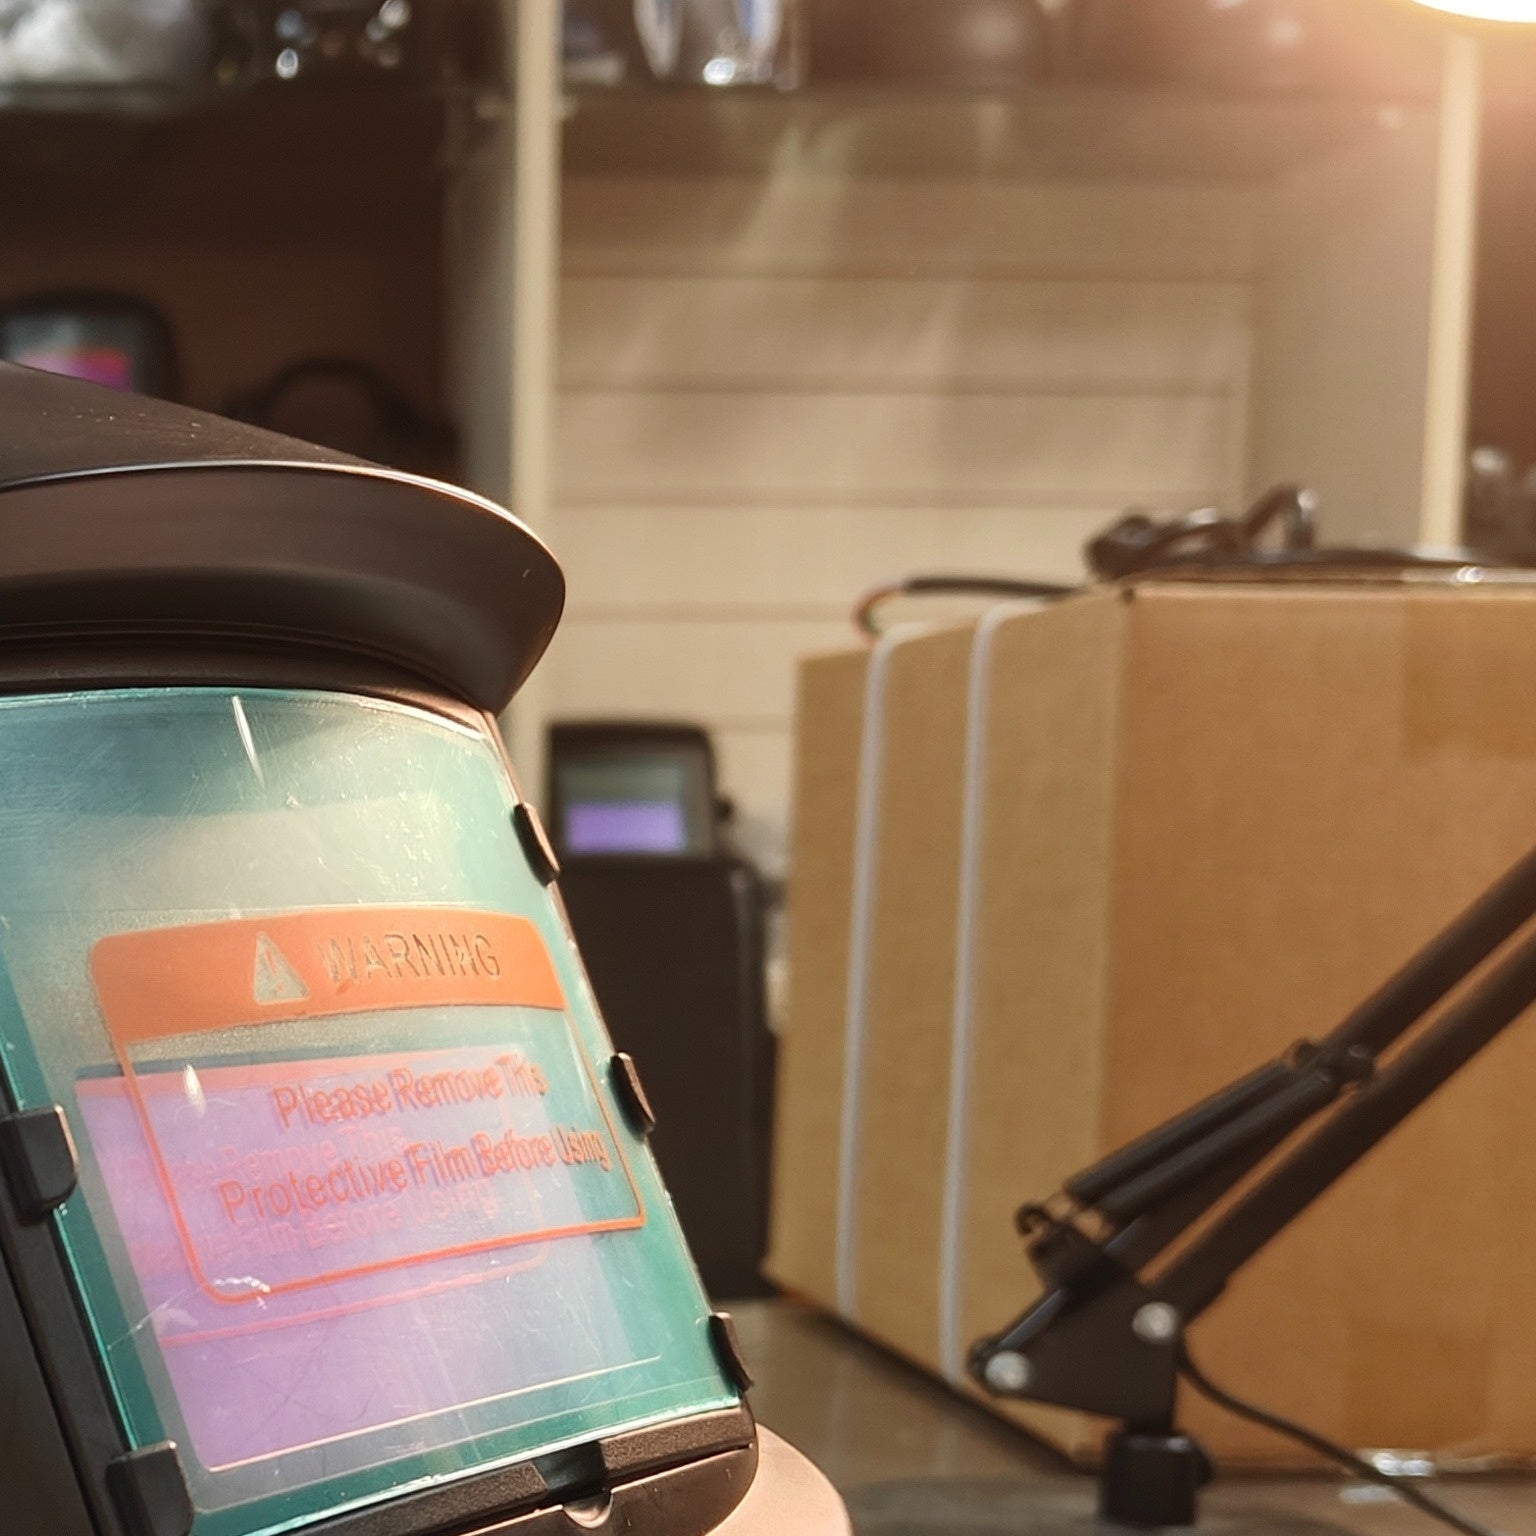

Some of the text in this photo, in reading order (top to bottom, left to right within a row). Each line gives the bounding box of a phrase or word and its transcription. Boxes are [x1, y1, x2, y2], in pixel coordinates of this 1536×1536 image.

[316, 933, 501, 984] WARNING
[271, 1053, 549, 1130] Please Remove This
[218, 1157, 409, 1226] Protective
[404, 1141, 478, 1187] Film
[471, 1128, 557, 1177] Before
[549, 1126, 613, 1173] Using
